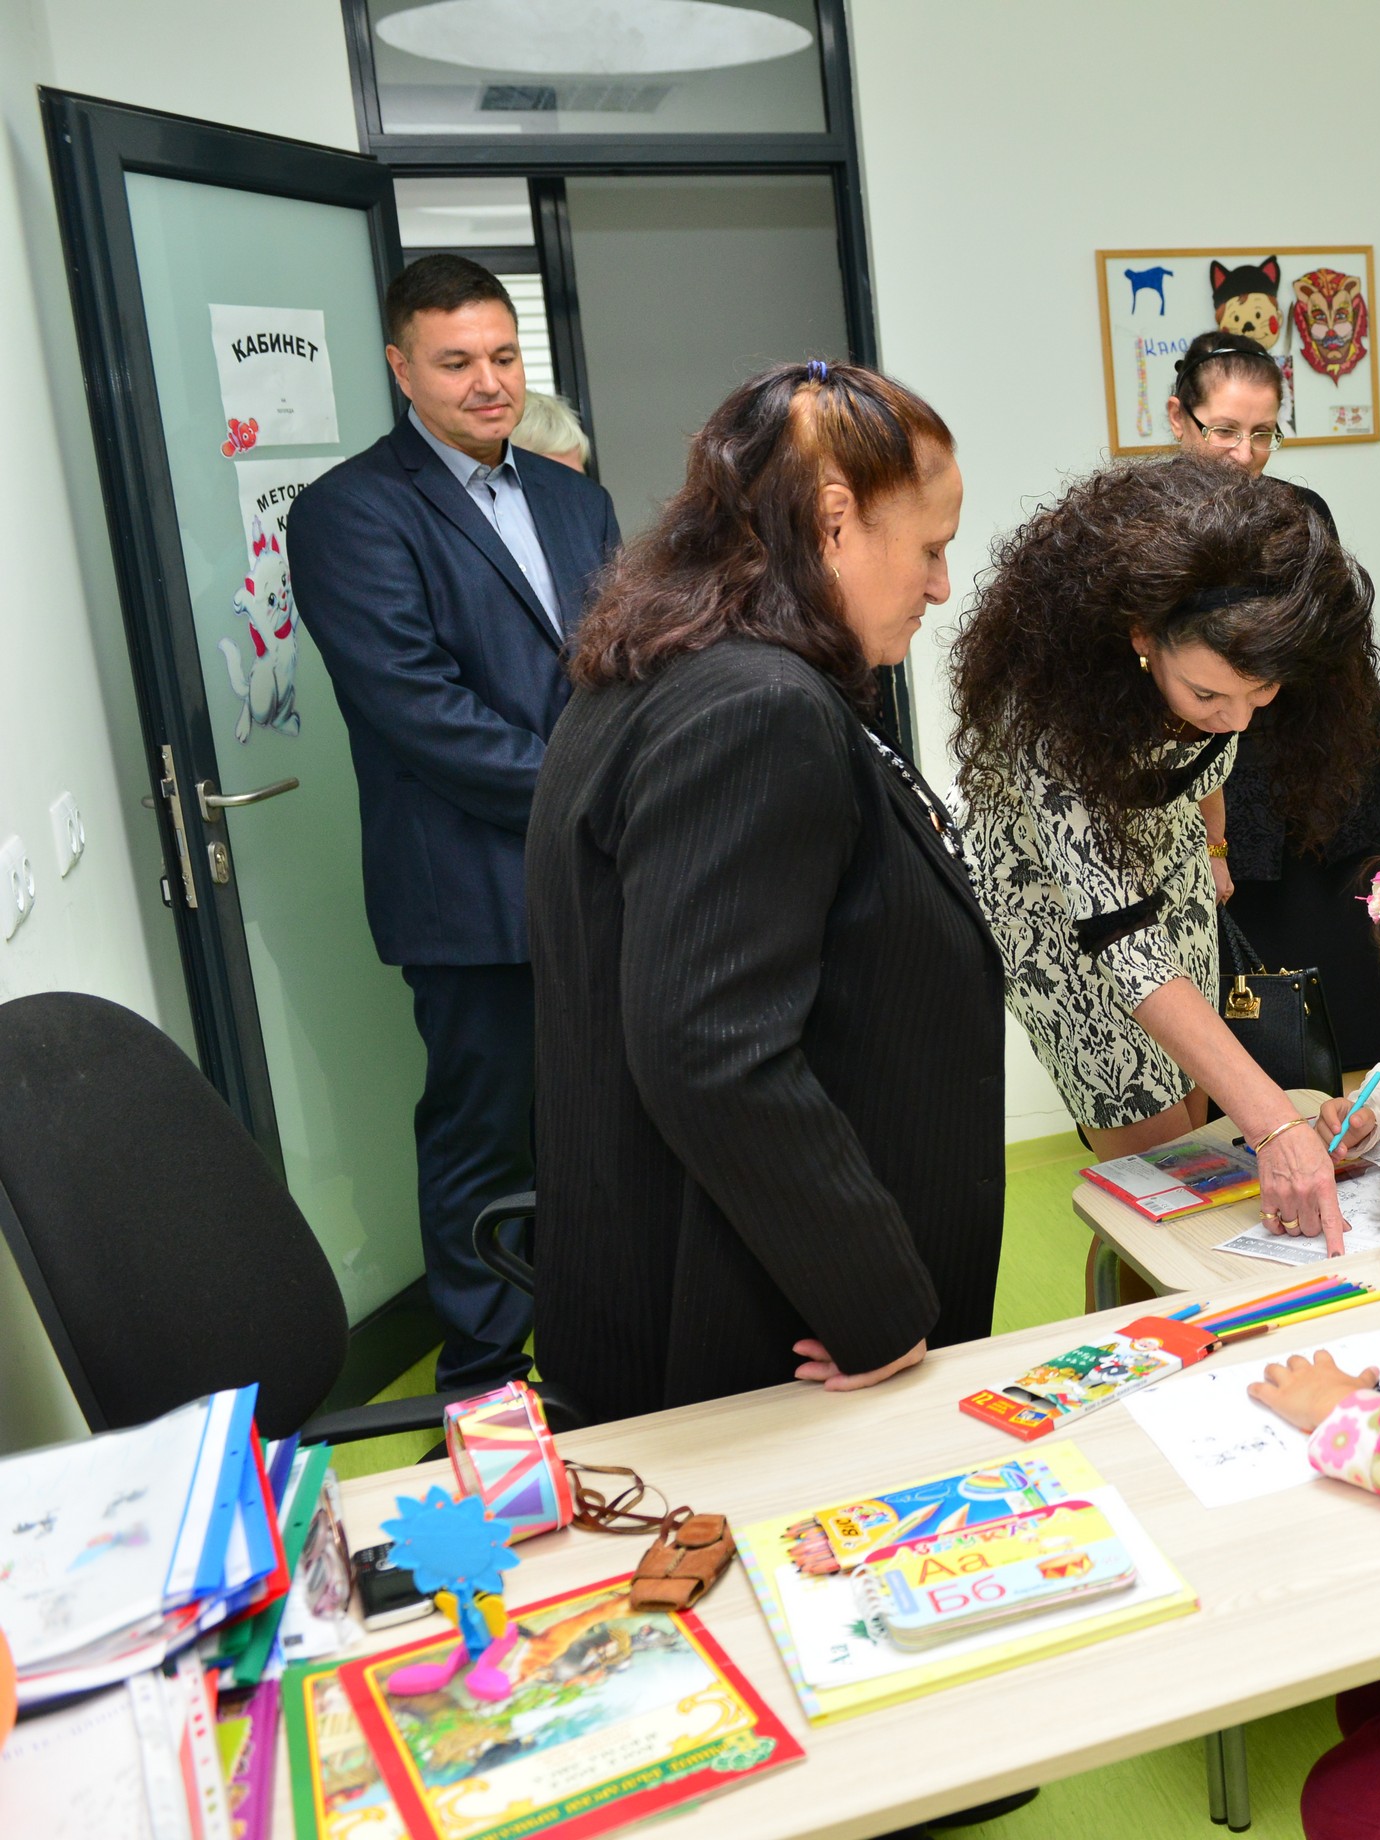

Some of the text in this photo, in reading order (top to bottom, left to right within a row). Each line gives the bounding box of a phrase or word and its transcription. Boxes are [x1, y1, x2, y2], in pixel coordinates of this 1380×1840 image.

[232, 332, 319, 363] КАБИНЕТ
[1144, 337, 1189, 356] КАЛО
[257, 483, 311, 513] МЕТО
[971, 1391, 994, 1405] 12
[835, 1518, 859, 1539] BIC
[918, 1551, 993, 1585] Аа
[927, 1574, 1007, 1615] Бб
